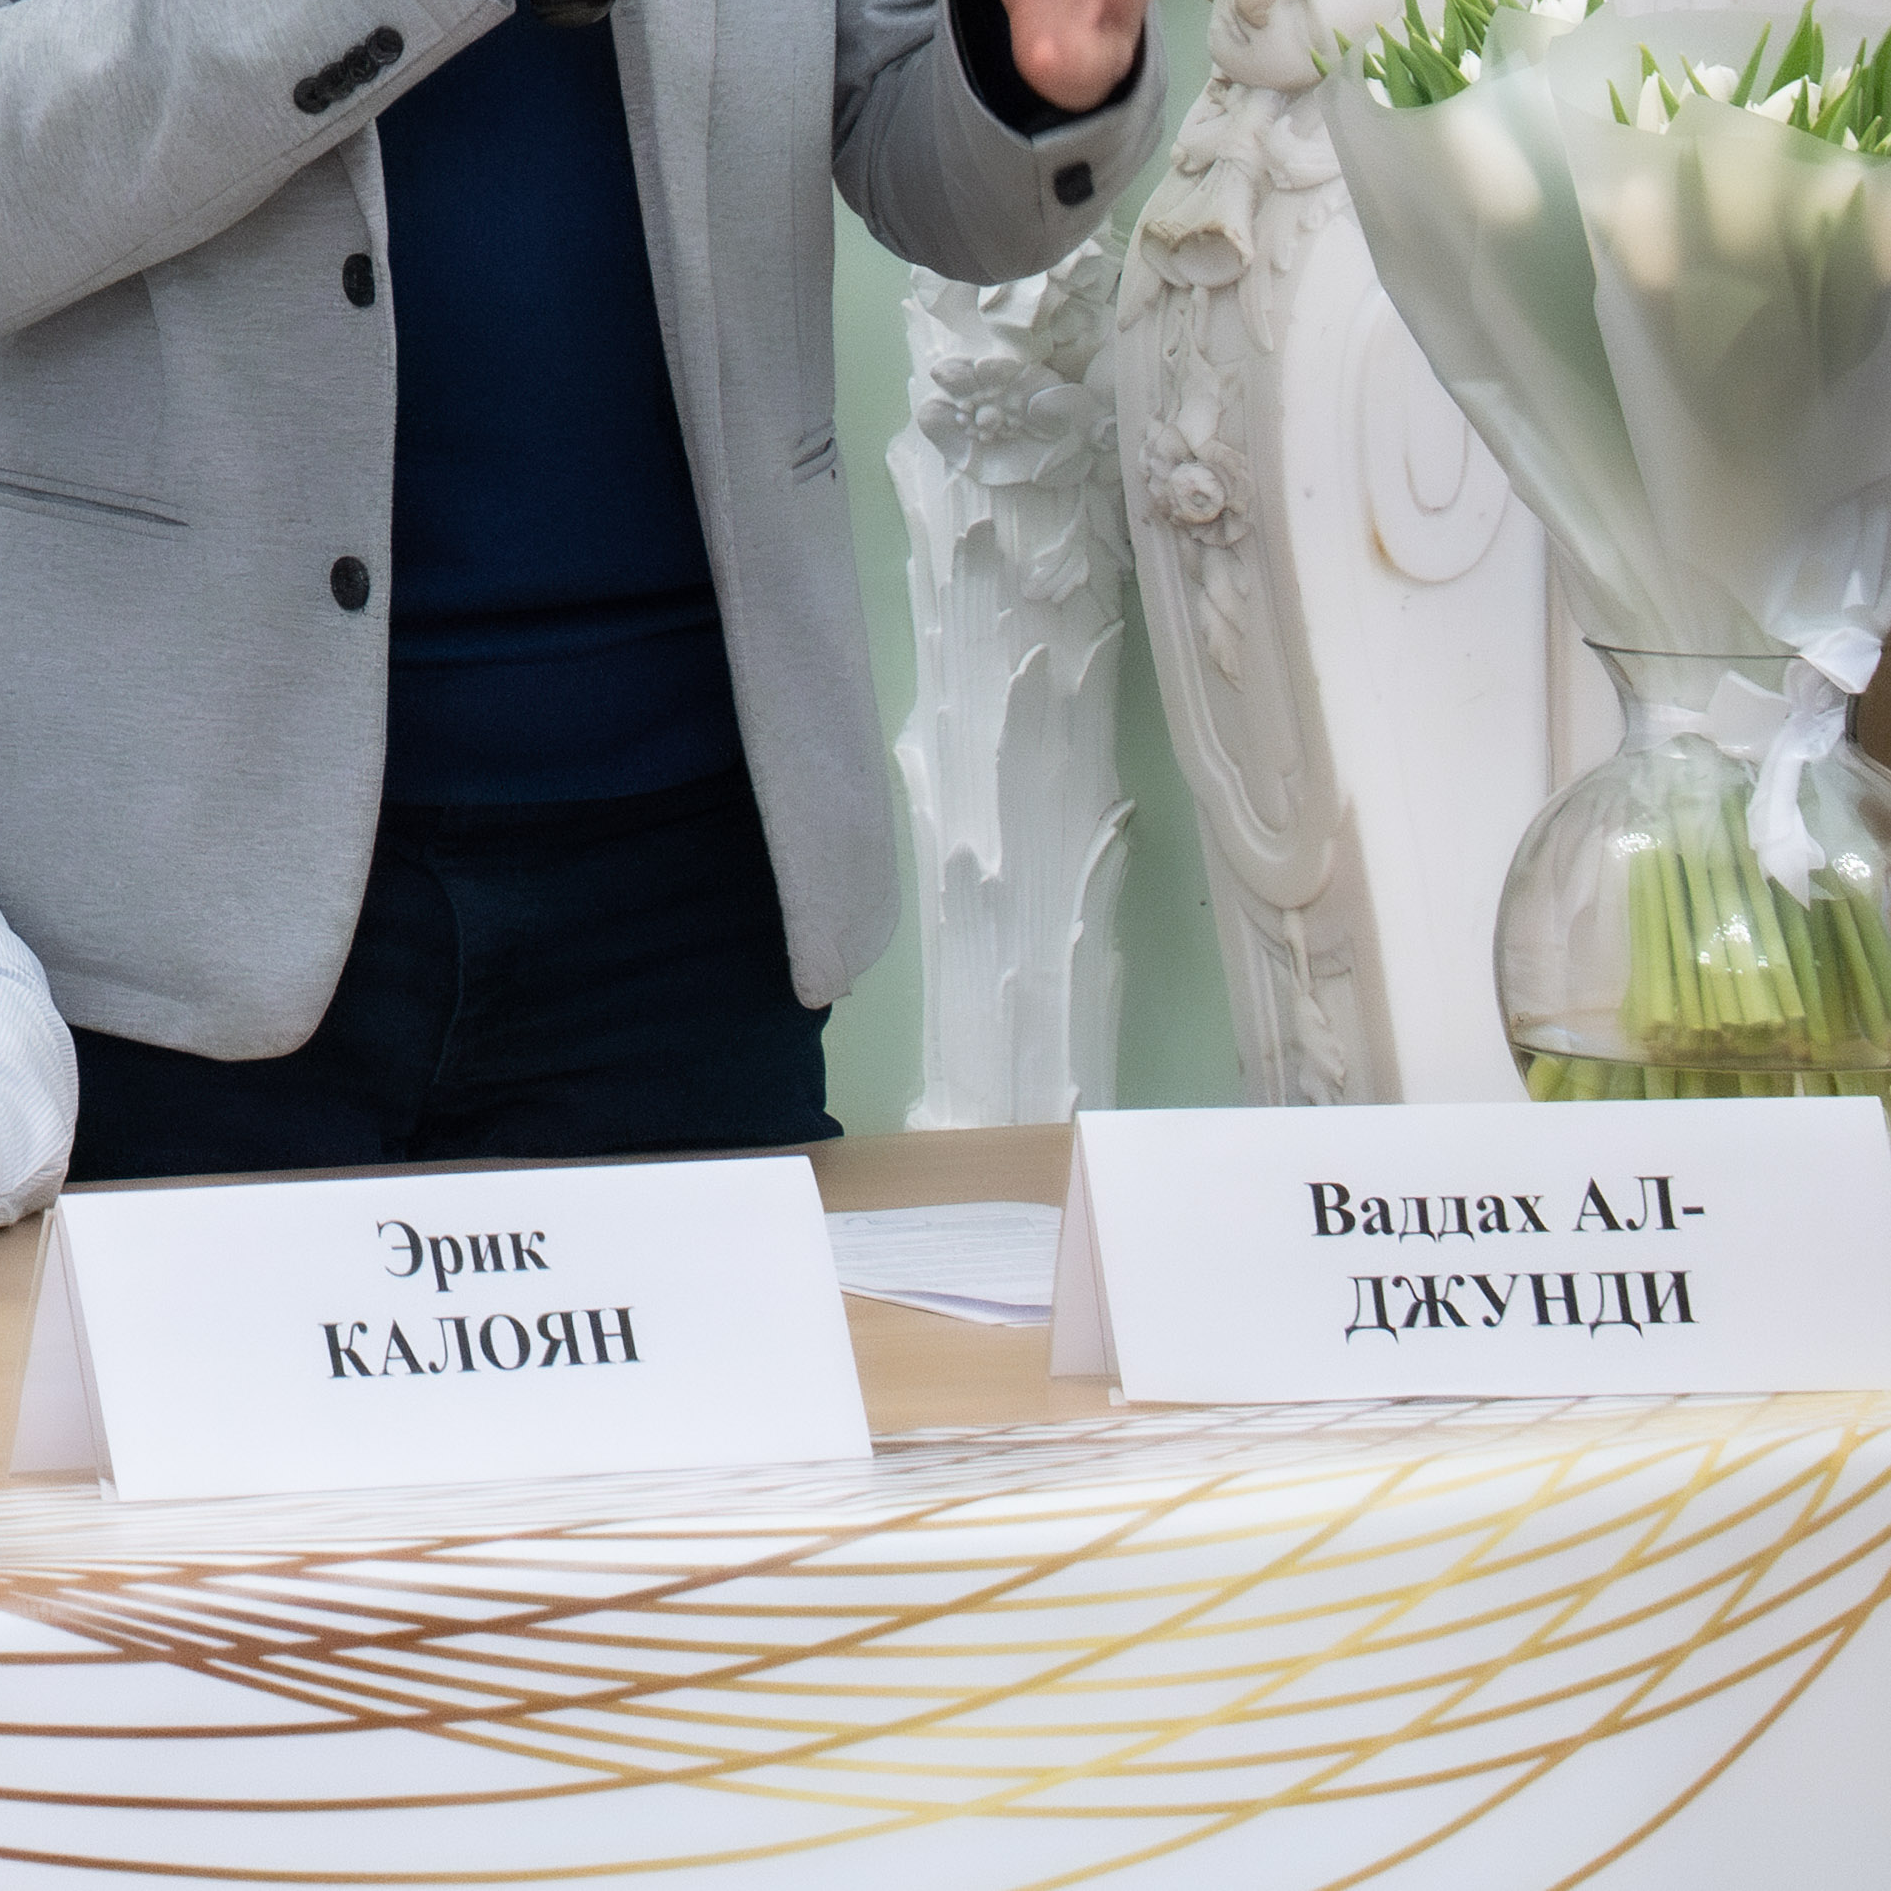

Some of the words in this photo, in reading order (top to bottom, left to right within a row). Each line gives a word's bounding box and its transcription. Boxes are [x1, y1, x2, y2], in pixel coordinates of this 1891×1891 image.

[1306, 1180, 1552, 1244] Ваддах
[1571, 1174, 1707, 1234] АЛ-
[375, 1218, 551, 1295] Эрик
[320, 1305, 642, 1380] КАЛОЯН
[1343, 1269, 1697, 1343] ДЖУНДИ
